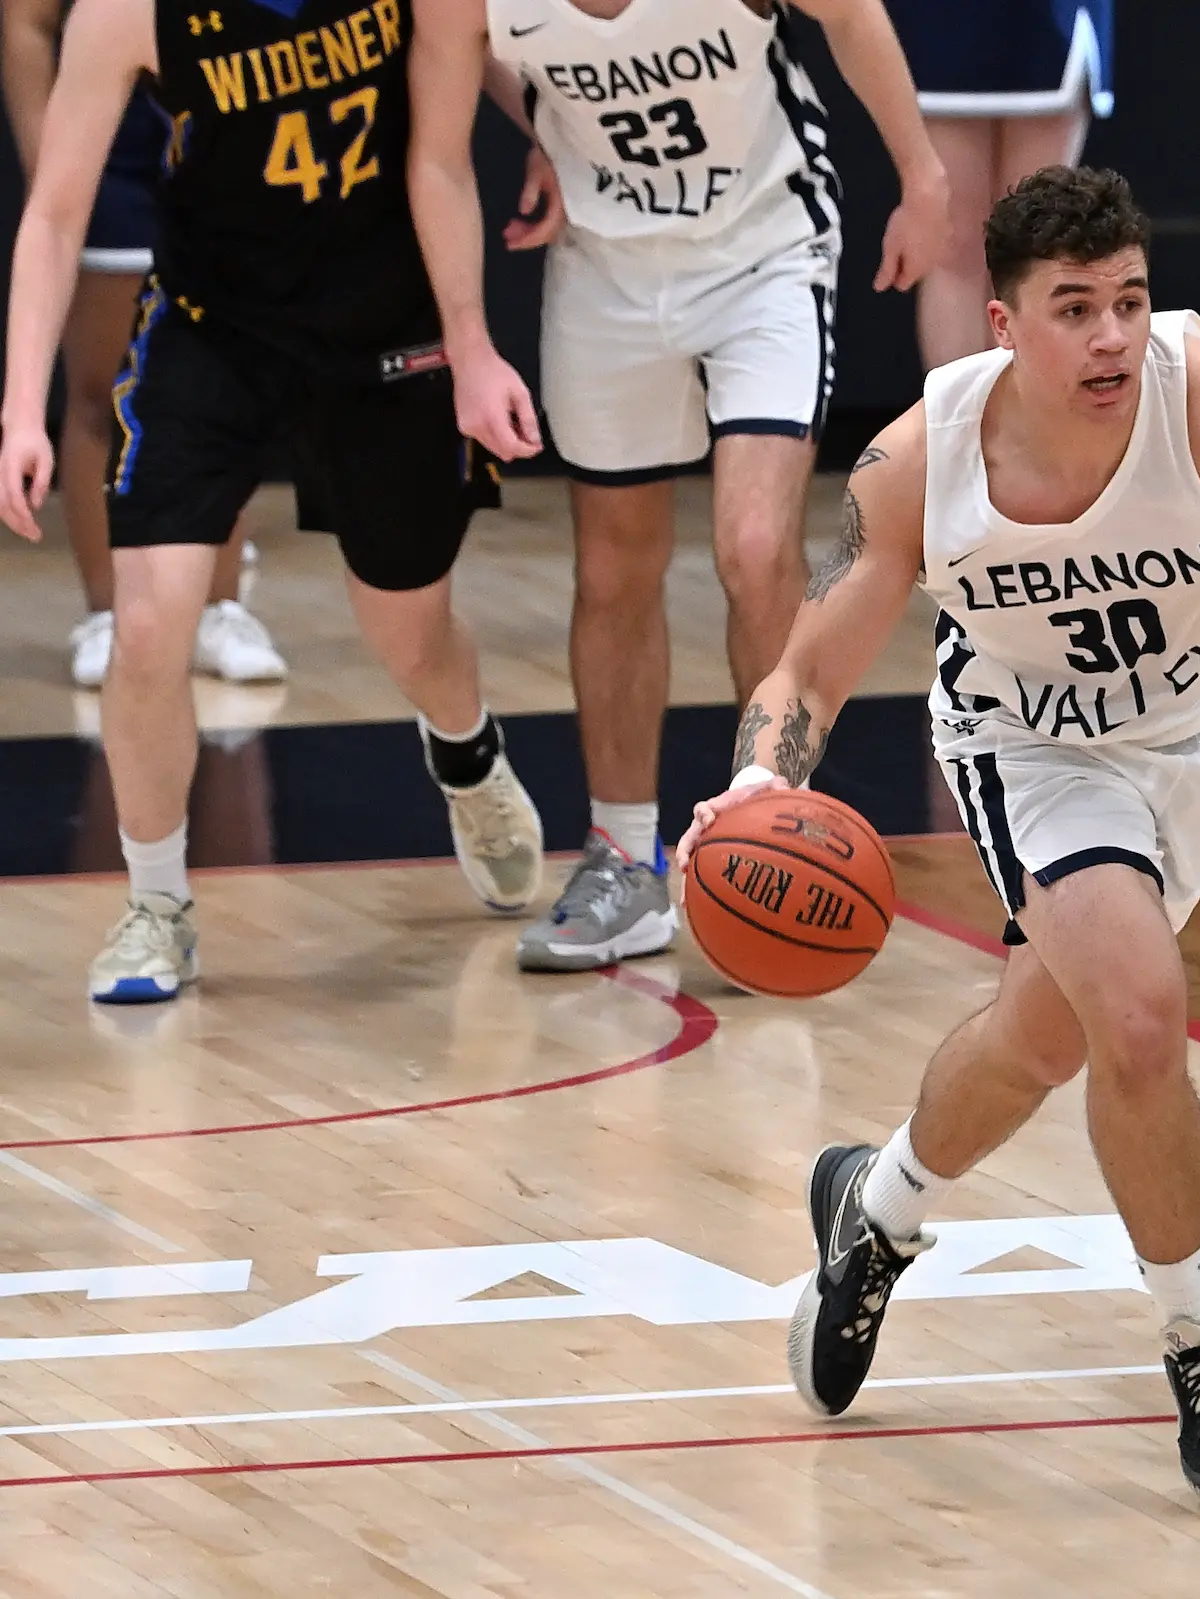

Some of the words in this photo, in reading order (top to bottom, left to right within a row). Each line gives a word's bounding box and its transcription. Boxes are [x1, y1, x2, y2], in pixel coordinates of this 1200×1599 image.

[199, 0, 401, 114] WIDENER
[545, 29, 737, 104] EBANON
[263, 87, 380, 203] 42
[599, 97, 709, 168] 23
[1047, 598, 1167, 674] 30
[721, 854, 794, 914] ROCK
[796, 882, 856, 931] THE
